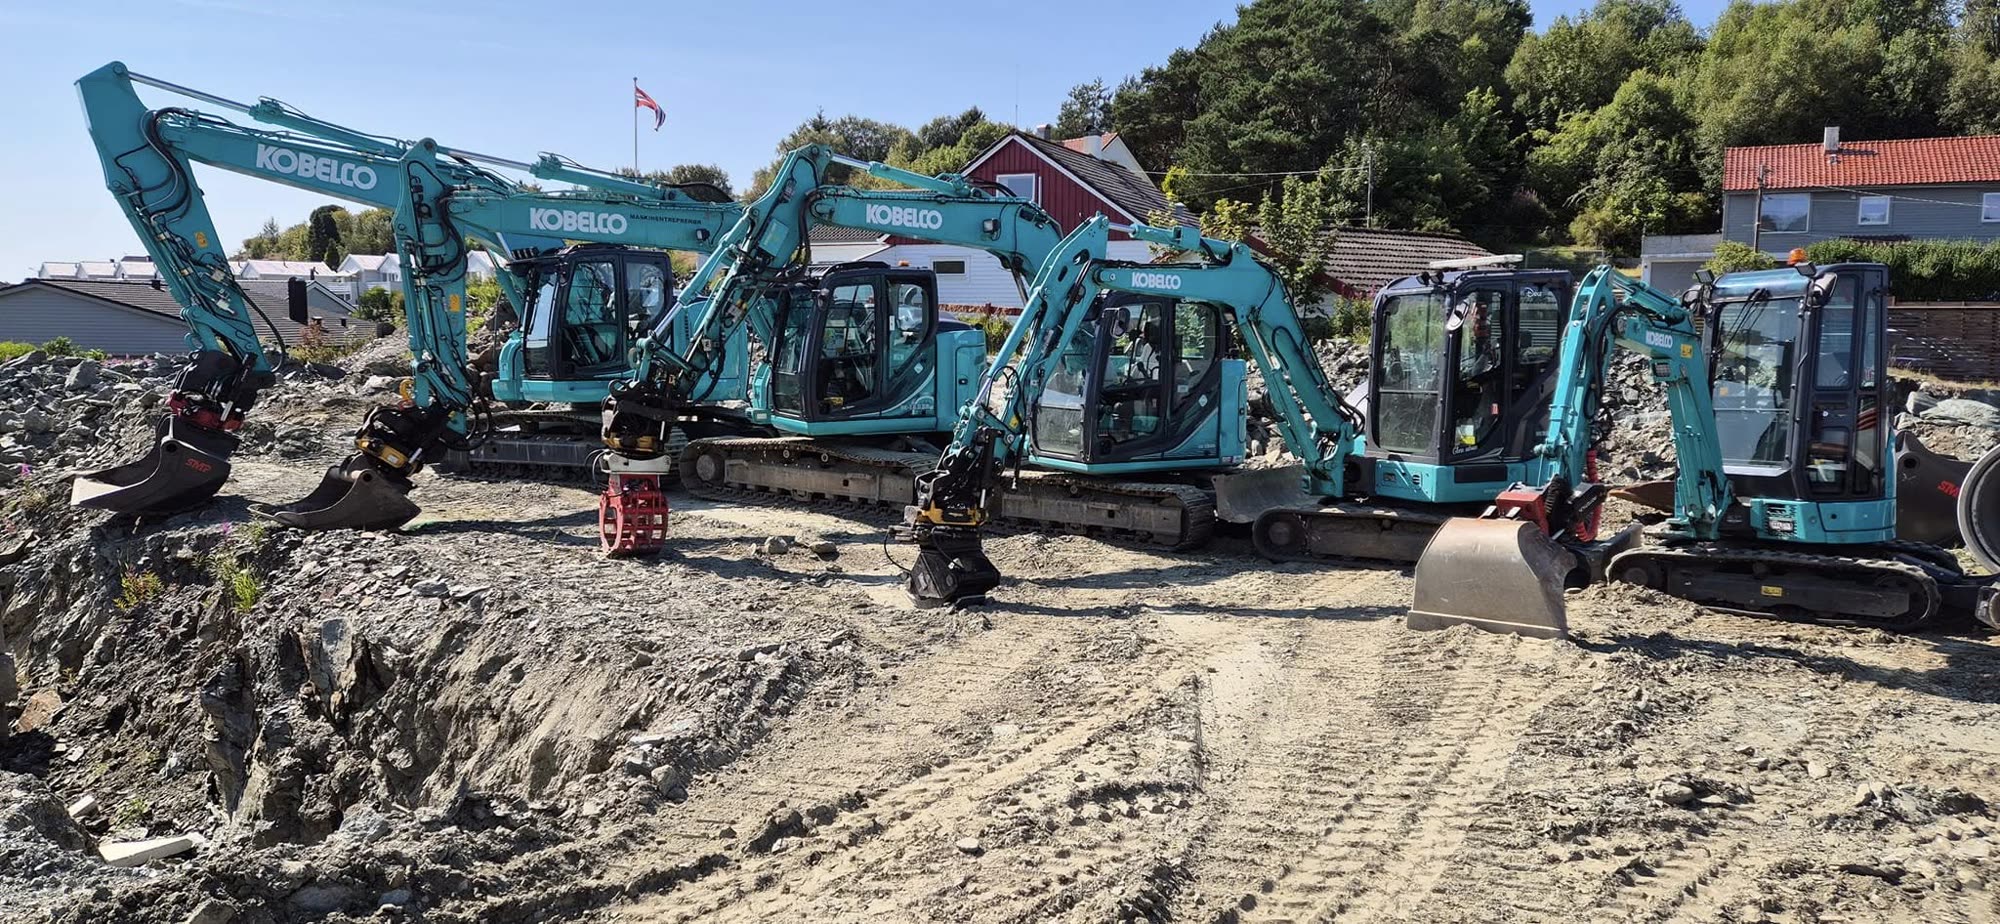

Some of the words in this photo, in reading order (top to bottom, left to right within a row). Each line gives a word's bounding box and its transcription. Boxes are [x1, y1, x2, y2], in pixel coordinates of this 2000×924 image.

[256, 143, 377, 190] KOBELCO
[530, 207, 628, 235] KOBELCO
[865, 203, 943, 230] KOBELCO
[1131, 271, 1181, 290] KOBELCO
[185, 458, 213, 473] SMP
[1936, 480, 1960, 497] SM
